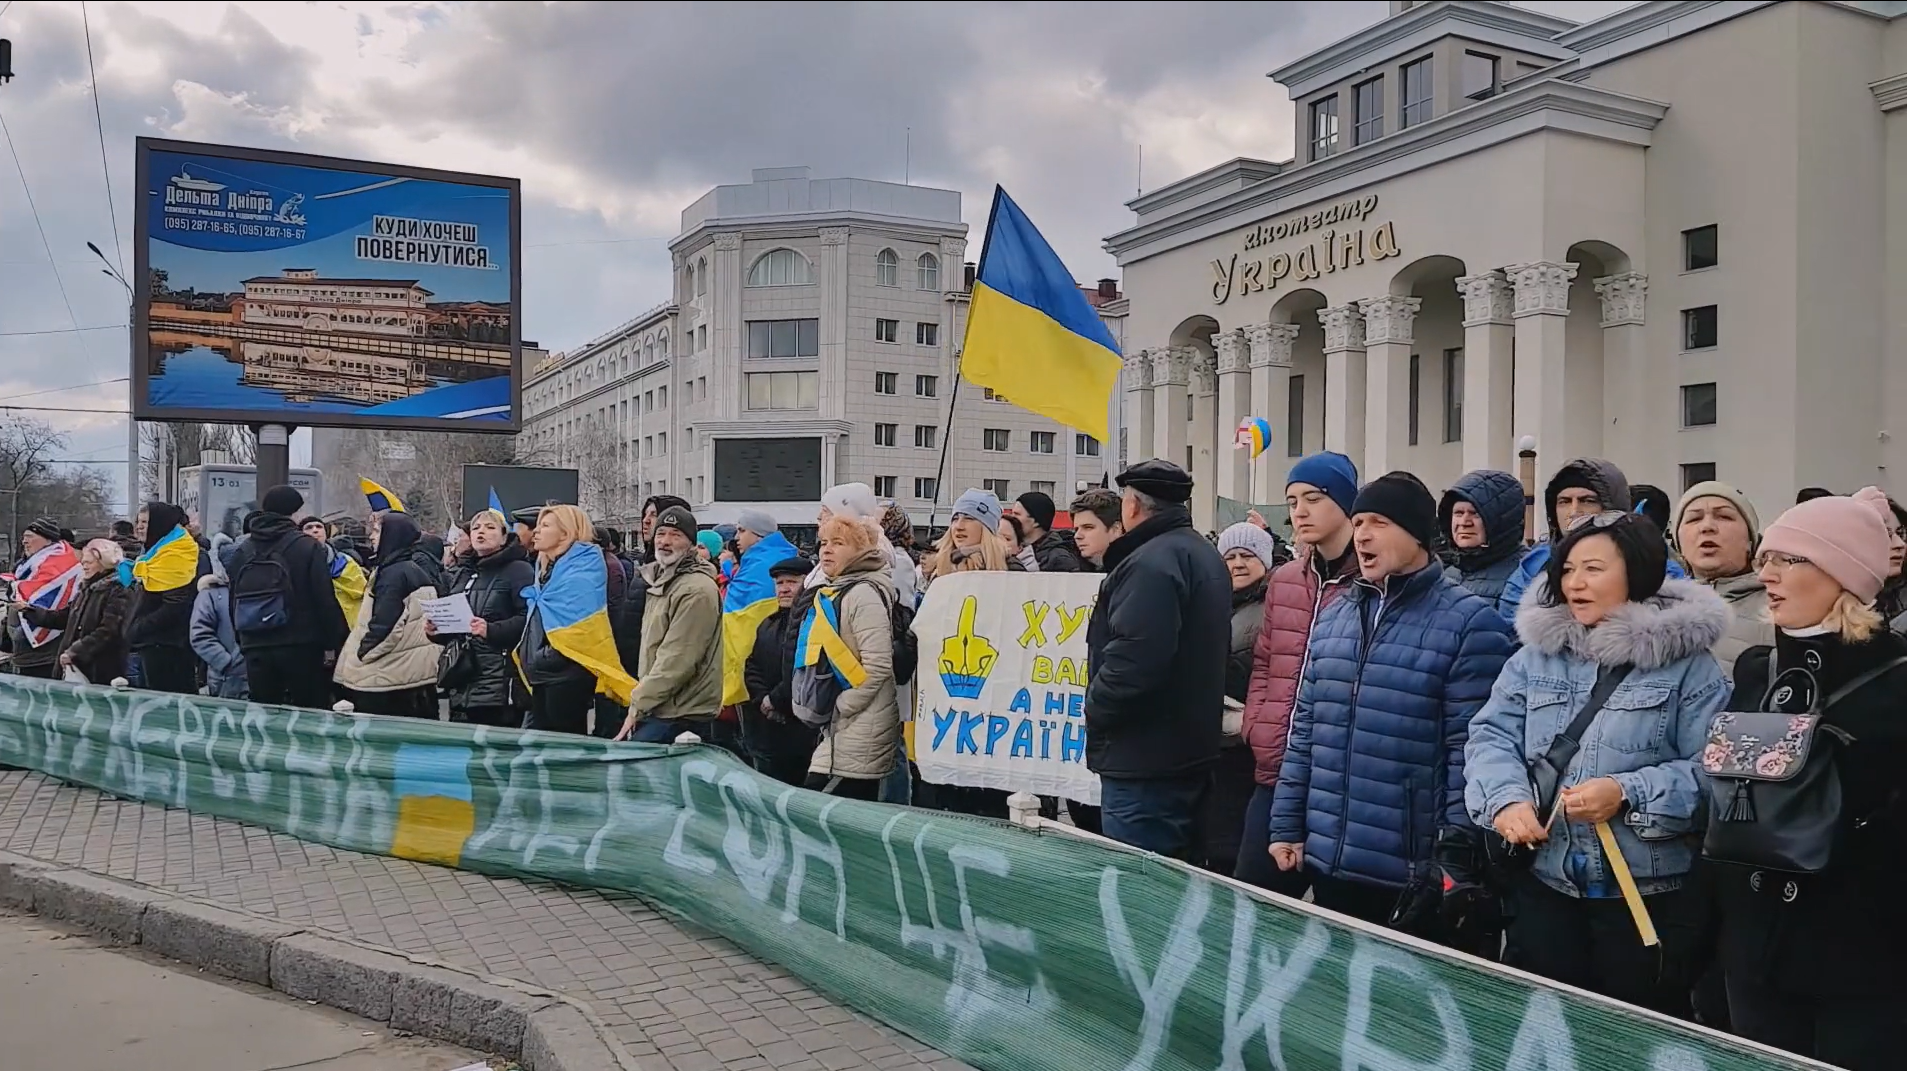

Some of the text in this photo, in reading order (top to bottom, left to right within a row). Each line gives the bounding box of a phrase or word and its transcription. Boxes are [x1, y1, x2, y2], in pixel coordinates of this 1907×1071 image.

[165, 185, 273, 214] Дельта Дніпра
[164, 217, 306, 239] (095) 287-16-65, (095) 287-16-67
[375, 216, 476, 243] КУДИ ХОЧЕШ
[1209, 220, 1401, 305] Україна
[212, 477, 225, 487] 13
[1017, 593, 1099, 649] ХУ
[1008, 686, 1087, 718] А НЕ
